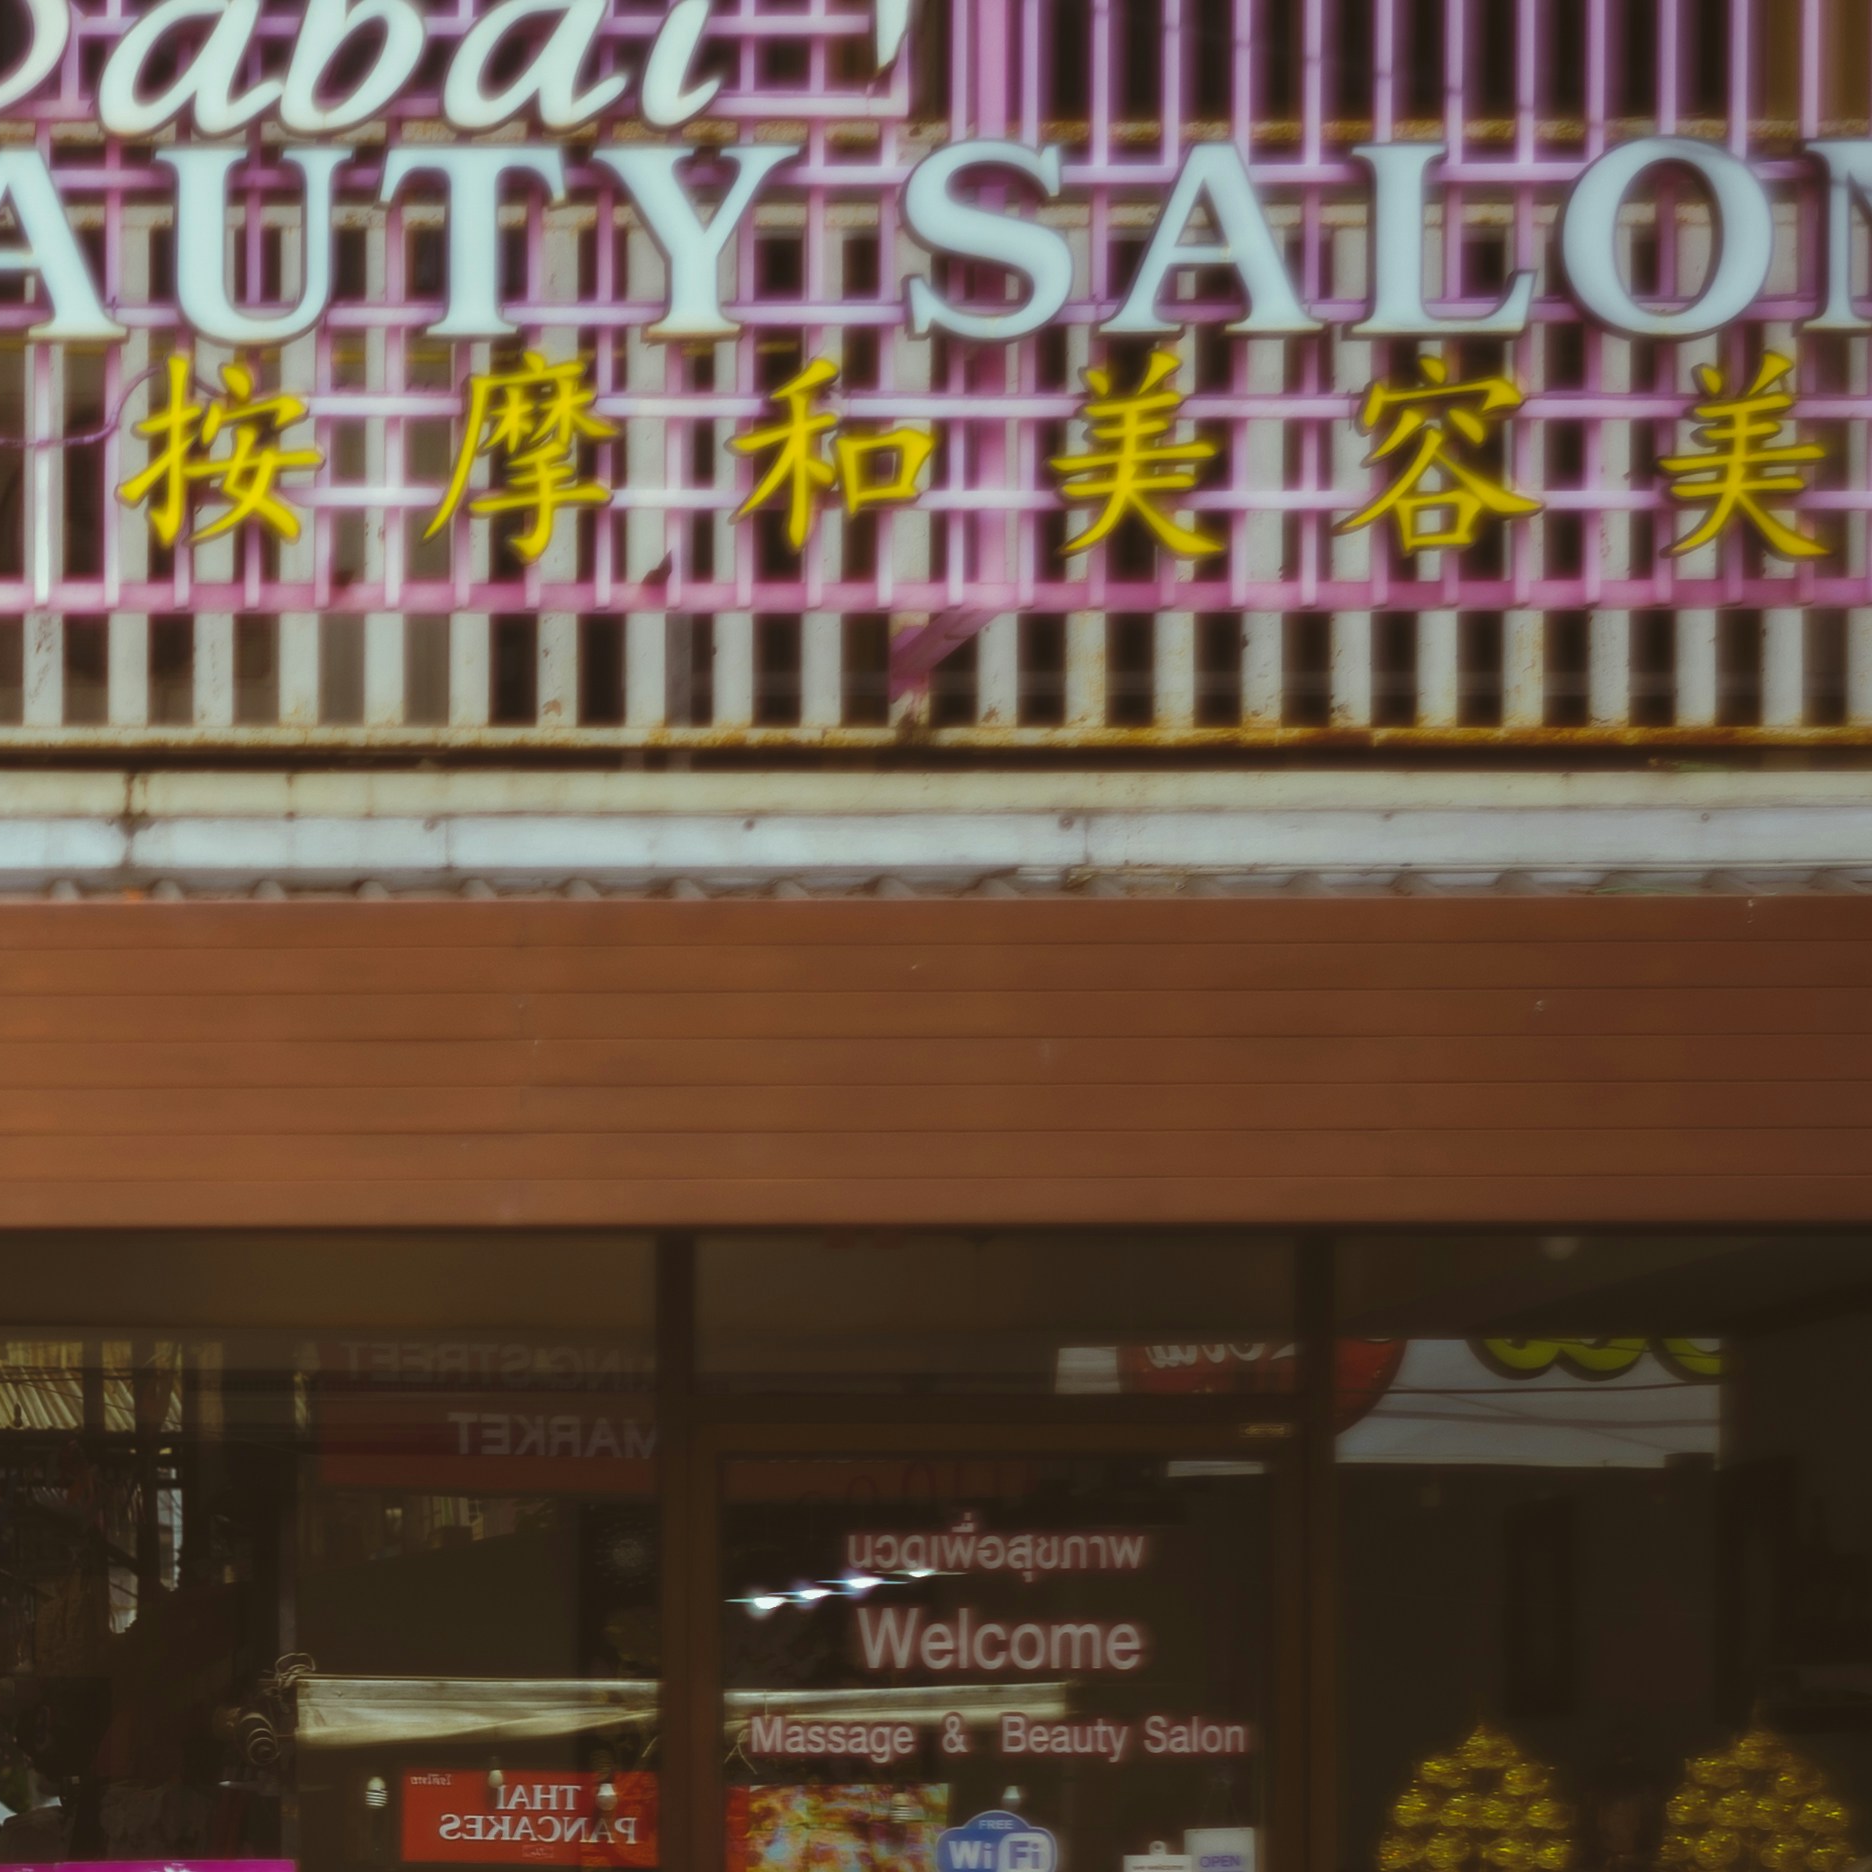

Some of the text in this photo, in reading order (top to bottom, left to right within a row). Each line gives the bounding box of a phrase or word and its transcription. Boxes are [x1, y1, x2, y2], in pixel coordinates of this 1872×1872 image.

[856, 1606, 1143, 1671] Welcome
[750, 1713, 1247, 1764] Massage & Beauty Salon
[978, 1818, 1015, 1831] FREE
[1199, 1854, 1241, 1869] OPEN
